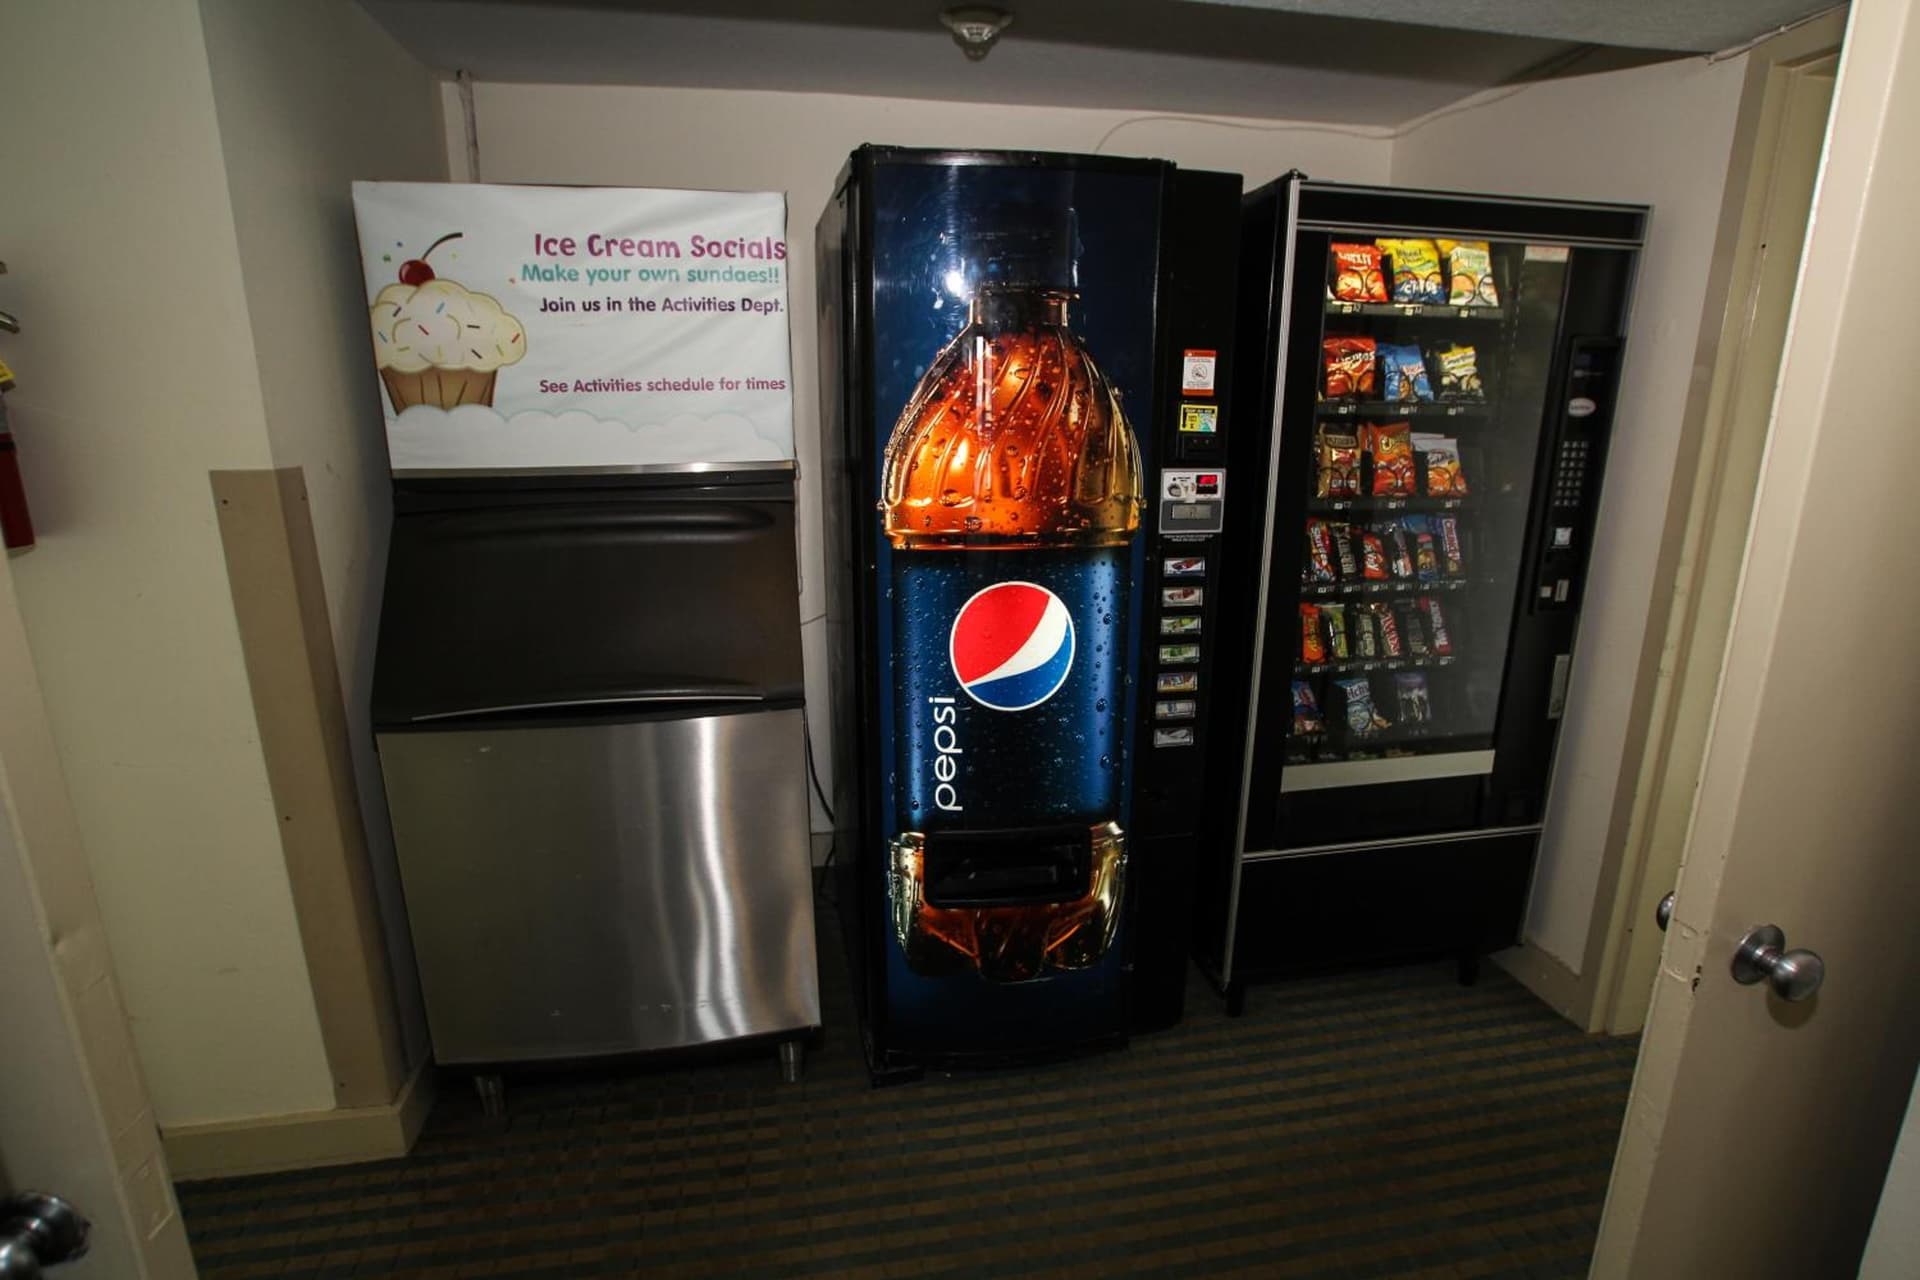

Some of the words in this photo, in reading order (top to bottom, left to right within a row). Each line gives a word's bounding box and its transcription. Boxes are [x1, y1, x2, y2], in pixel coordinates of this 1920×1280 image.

[535, 233, 576, 256] Ice
[587, 233, 681, 258] Cream
[690, 234, 787, 260] Socials
[521, 263, 579, 282] Make
[586, 267, 631, 286] your
[638, 268, 680, 282] own
[687, 265, 779, 284] sundaes!!
[539, 296, 576, 312] Join
[582, 299, 601, 312] us
[606, 296, 622, 312] in
[628, 296, 656, 312] the
[661, 296, 736, 312] Activities
[741, 297, 784, 316] Dept.
[539, 379, 569, 393] See
[573, 378, 642, 392] Activities
[647, 377, 715, 392] schedule
[719, 377, 741, 390] for
[745, 376, 786, 390] times
[928, 696, 964, 811] pepsi
